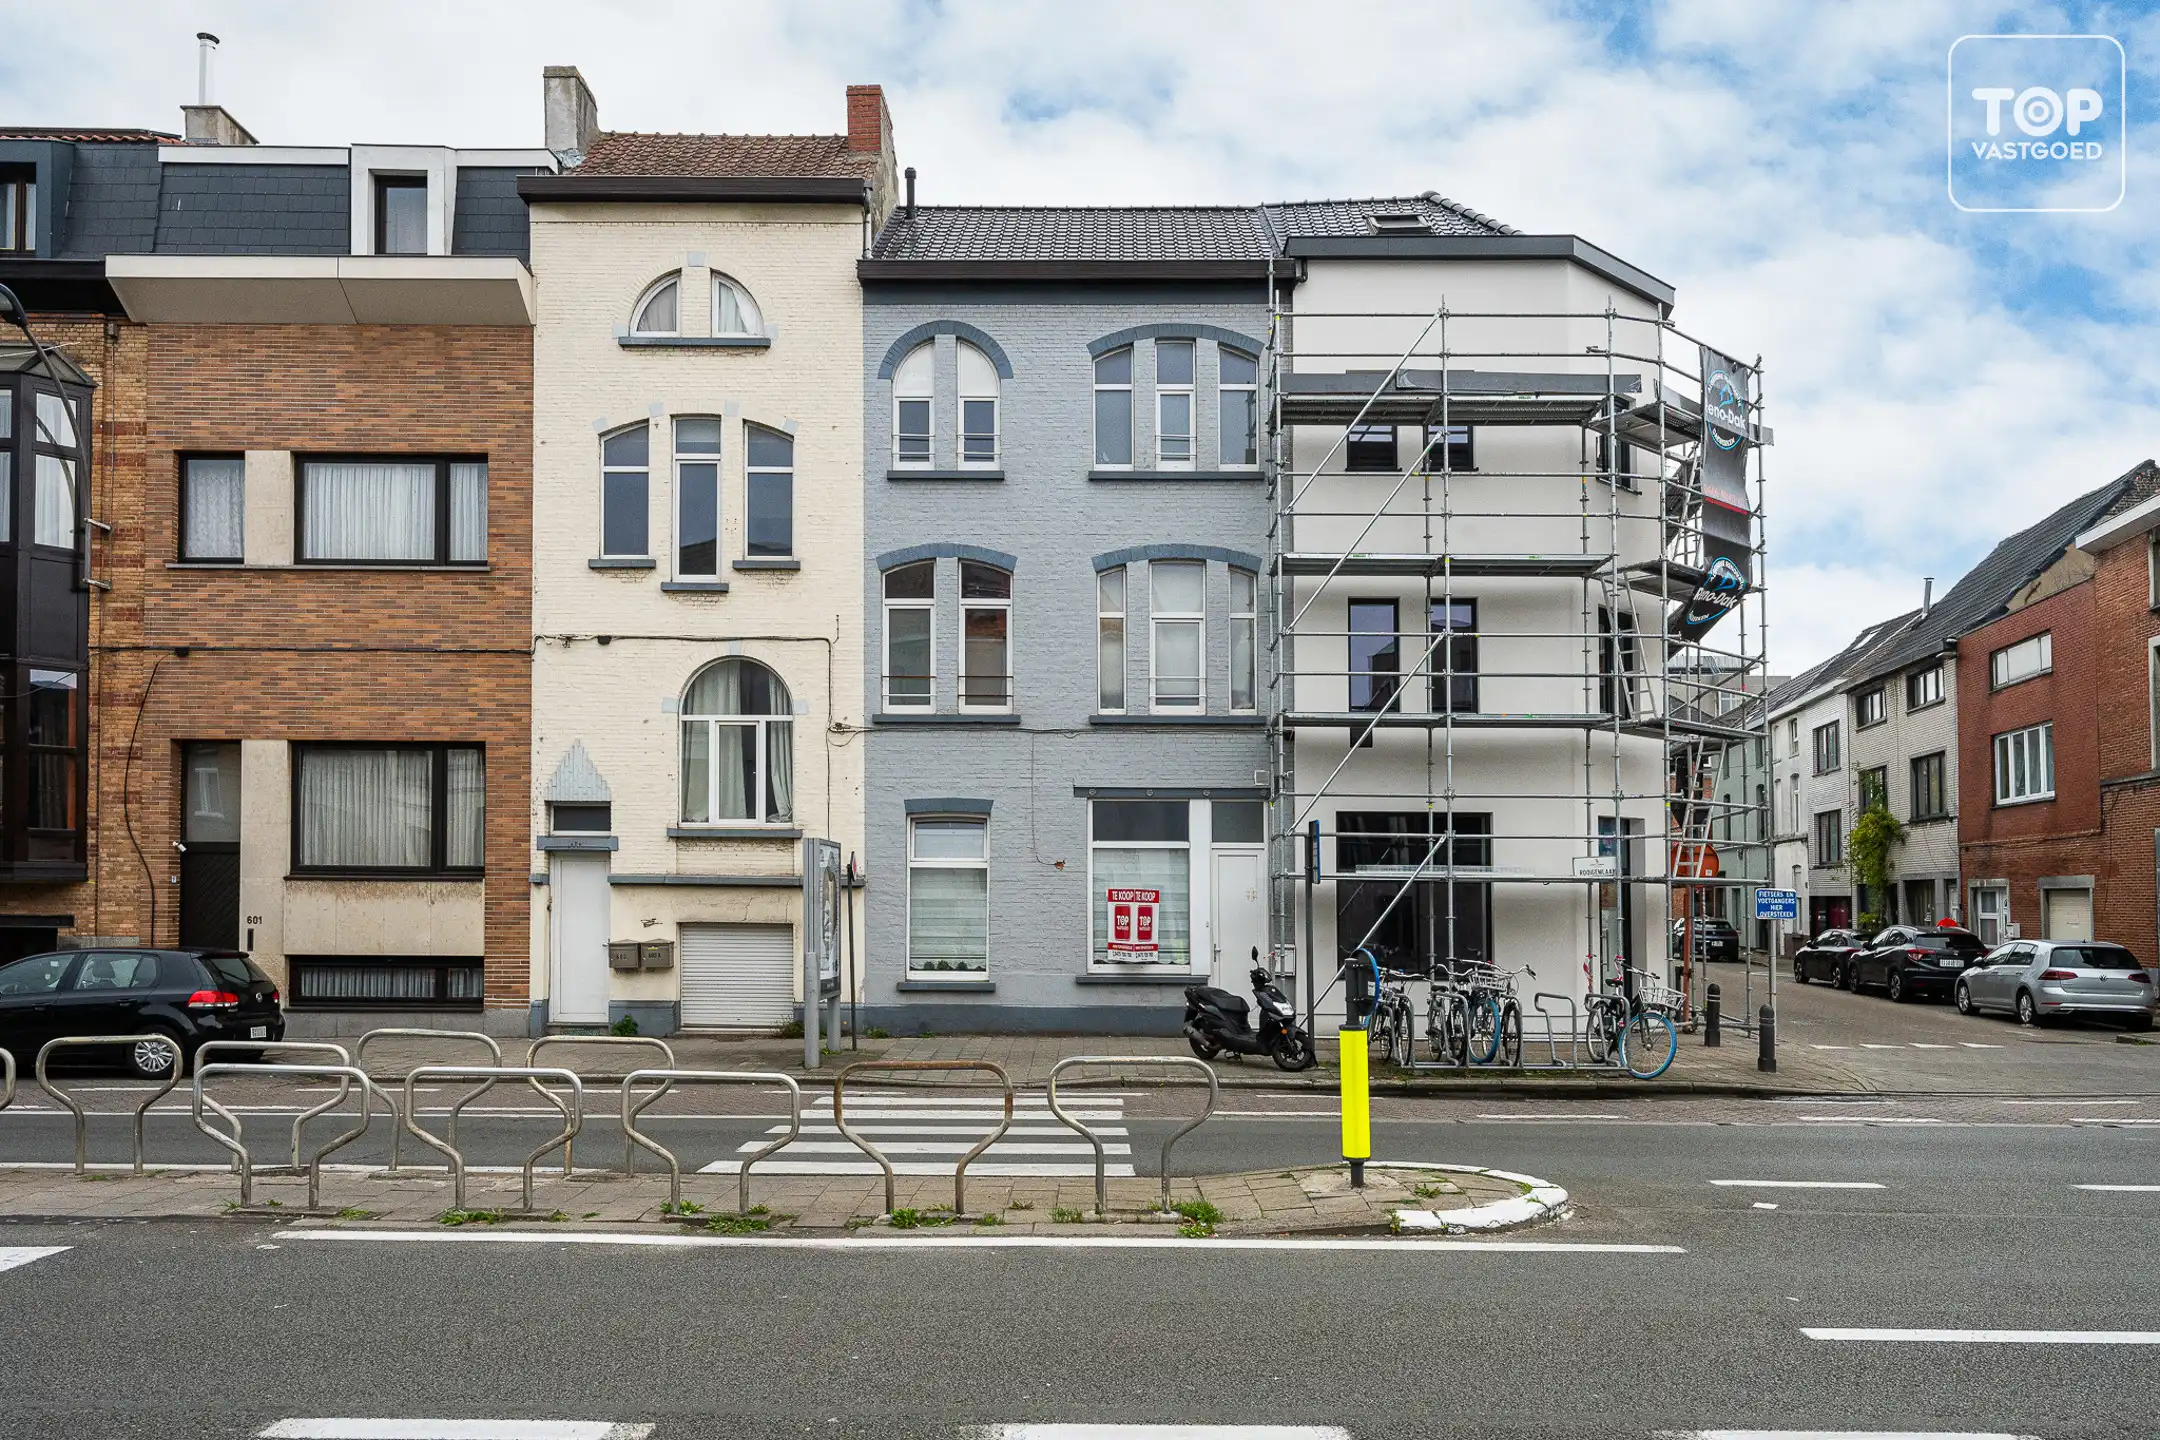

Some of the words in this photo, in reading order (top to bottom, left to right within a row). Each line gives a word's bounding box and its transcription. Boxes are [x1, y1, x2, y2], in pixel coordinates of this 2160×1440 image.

[1704, 403, 1746, 430] eno-Dak
[1112, 891, 1118, 901] TE
[1119, 891, 1134, 901] KOOP
[1135, 891, 1141, 901] TE
[1142, 892, 1156, 901] KOOP
[246, 915, 263, 925] 601
[1116, 915, 1129, 926] TOP
[1139, 916, 1151, 927] TOP
